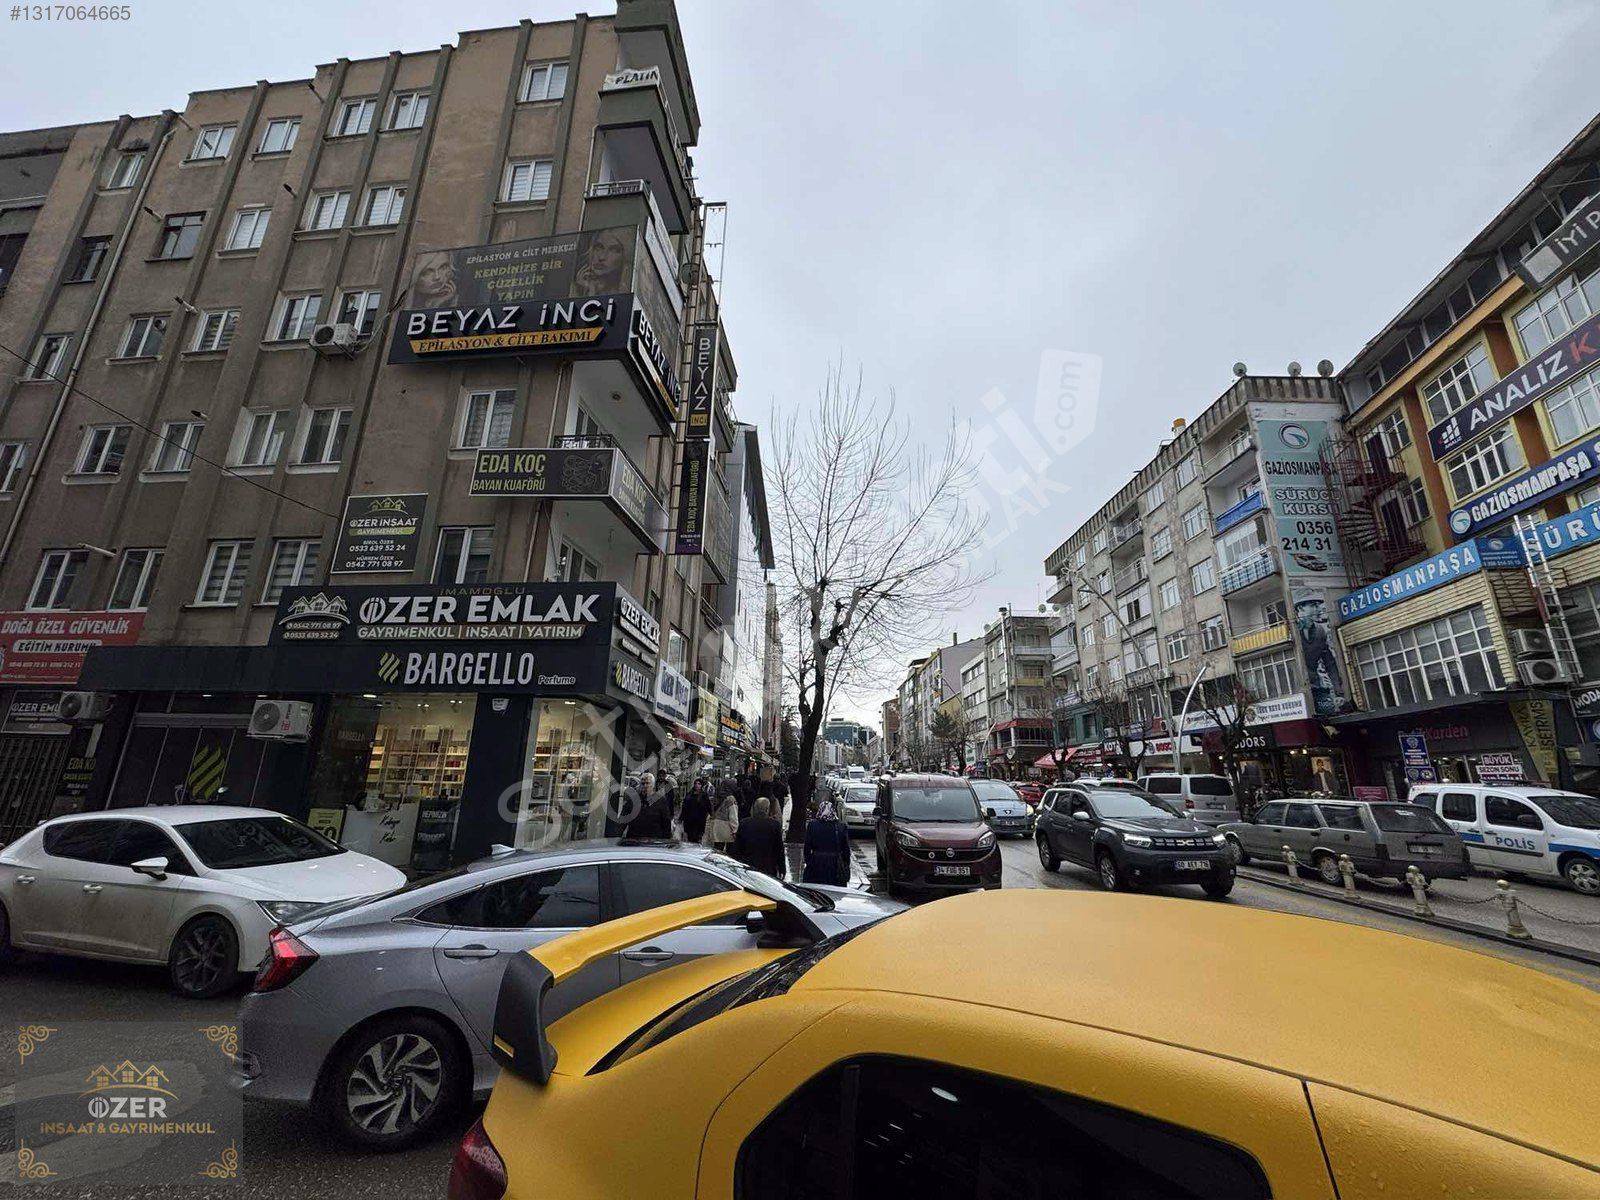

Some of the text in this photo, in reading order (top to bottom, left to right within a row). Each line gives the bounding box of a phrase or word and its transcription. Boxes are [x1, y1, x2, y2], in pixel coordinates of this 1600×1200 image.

[1555, 223, 1588, 254] İYİ
[466, 251, 511, 264] EPİLASYON
[522, 246, 540, 257] CİLT
[475, 259, 563, 279] KENDİNİZE BİR
[407, 298, 614, 336] BEYAZ İNCİ
[419, 331, 592, 351] EPİLASYON & CİLT BAKIMI
[694, 337, 712, 411] BEYAZ
[1469, 350, 1568, 431] ANALİZ
[478, 454, 546, 476] EDA KOÇ
[473, 477, 546, 490] BAYAN KUAFÖRÜ
[1471, 451, 1592, 522] GAZİOSMANPAŞA
[1296, 521, 1334, 535] 0356
[1282, 537, 1332, 551] 214 31
[1340, 547, 1476, 616] GAZİOSMANPAŞA
[359, 594, 600, 624] ÖZER EMLAK
[1, 617, 130, 634] DOĞA ÖZEL GÜVENLİK
[526, 625, 583, 638] YATIRIM
[18, 640, 53, 652] EĞİTİM
[404, 651, 577, 686] BARGELLO Perfume
[1494, 836, 1536, 850] POLİS
